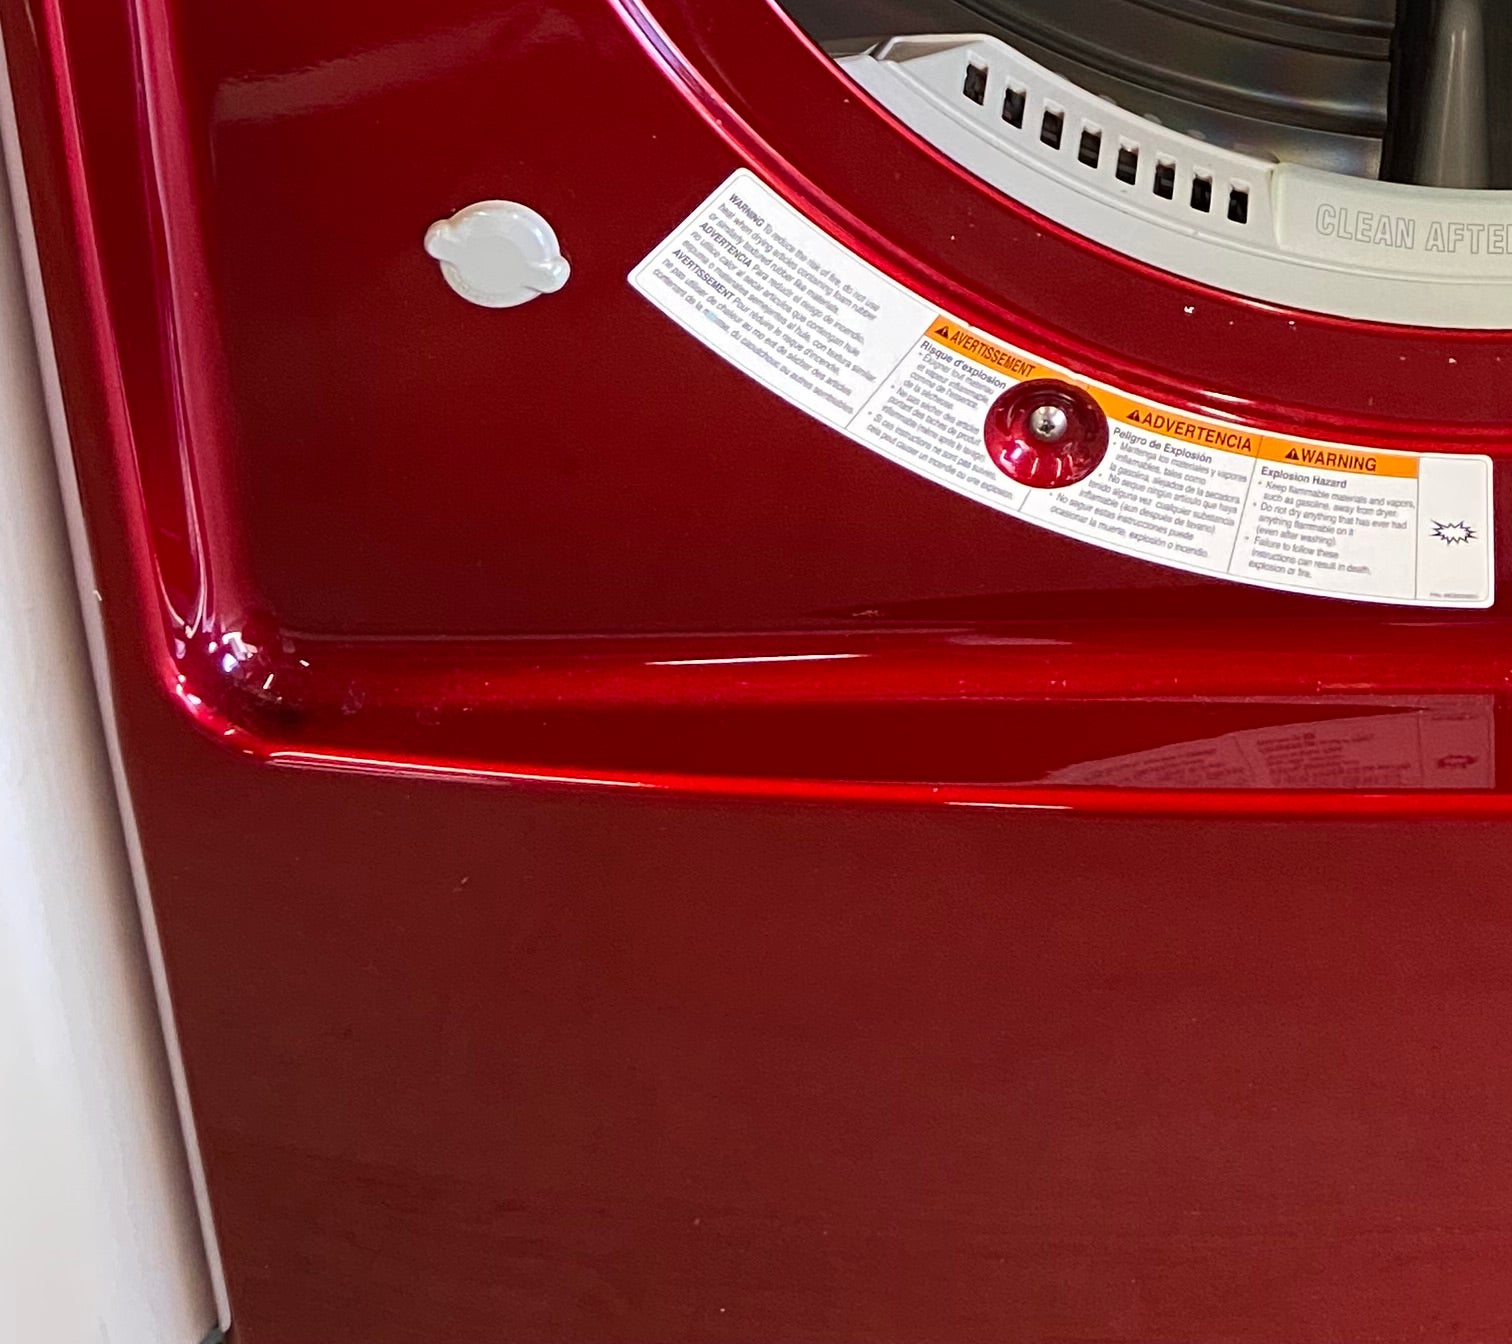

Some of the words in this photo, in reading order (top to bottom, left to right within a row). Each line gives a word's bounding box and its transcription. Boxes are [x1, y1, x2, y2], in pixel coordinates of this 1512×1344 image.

[729, 193, 766, 227] WARNING
[1315, 203, 1416, 250] CLEAN
[699, 221, 753, 268] ADVERTENCIA
[672, 248, 735, 301] AVERTISSEMENT
[920, 340, 954, 364] Risque
[954, 358, 1006, 390] d'explosion
[950, 330, 1036, 378] AVERTISSEMENT
[1113, 426, 1147, 446] Peligro
[1149, 438, 1161, 450] de
[1164, 444, 1212, 464] Explosión
[1142, 412, 1252, 451] ADVERTENCIA
[1261, 466, 1310, 483] Explosion
[1312, 475, 1347, 488] Hazard
[1301, 449, 1377, 472] WARNING
